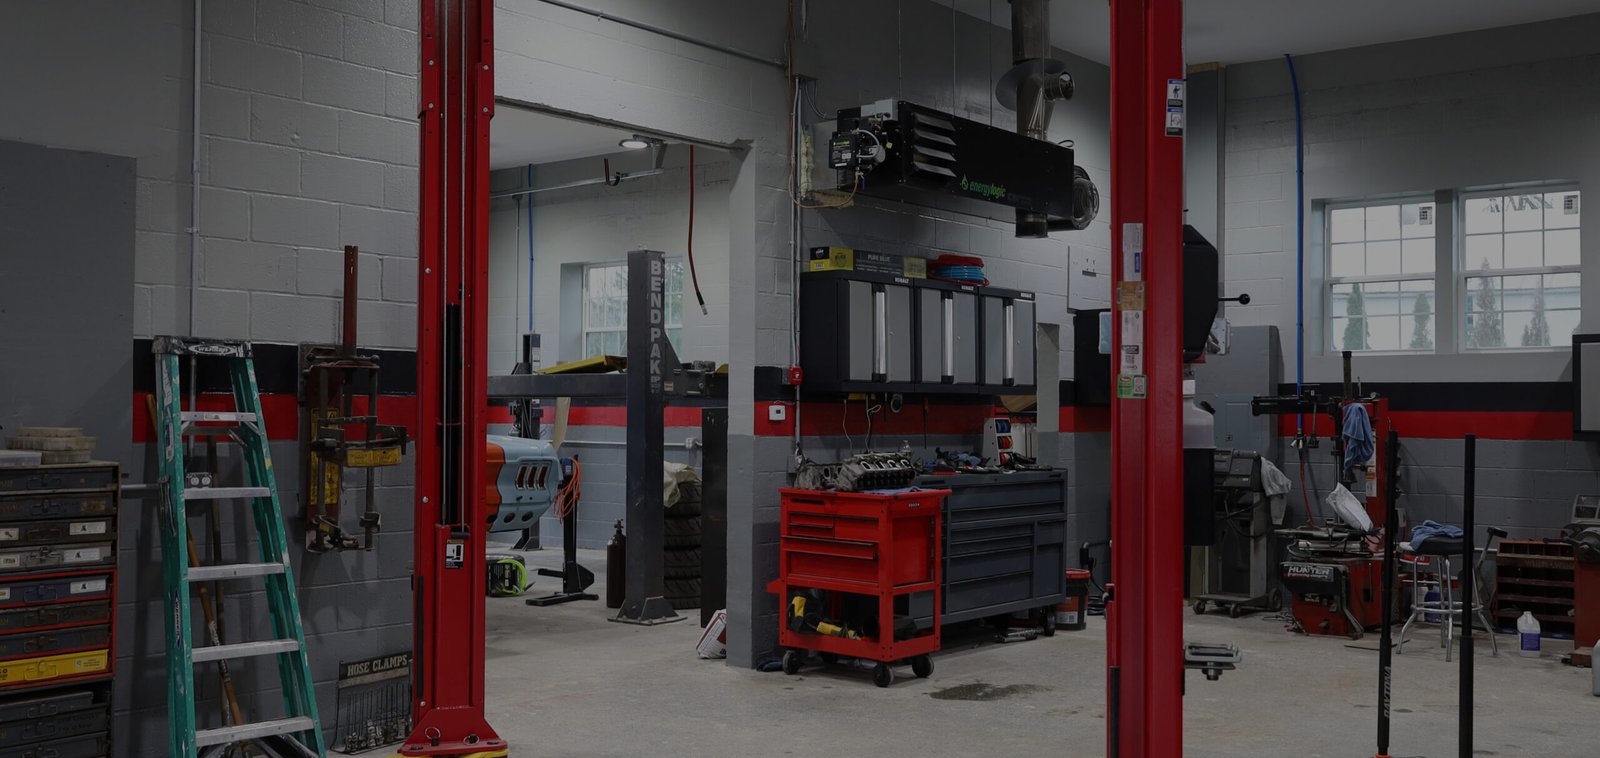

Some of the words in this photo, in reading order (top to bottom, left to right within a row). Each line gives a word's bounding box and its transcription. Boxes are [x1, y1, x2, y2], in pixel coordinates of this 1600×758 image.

[969, 181, 1006, 199] energylogic
[650, 259, 662, 375] BENDPAK
[1288, 566, 1329, 575] HUNTER
[347, 662, 370, 677] HOSE
[373, 654, 407, 672] CLAMPS
